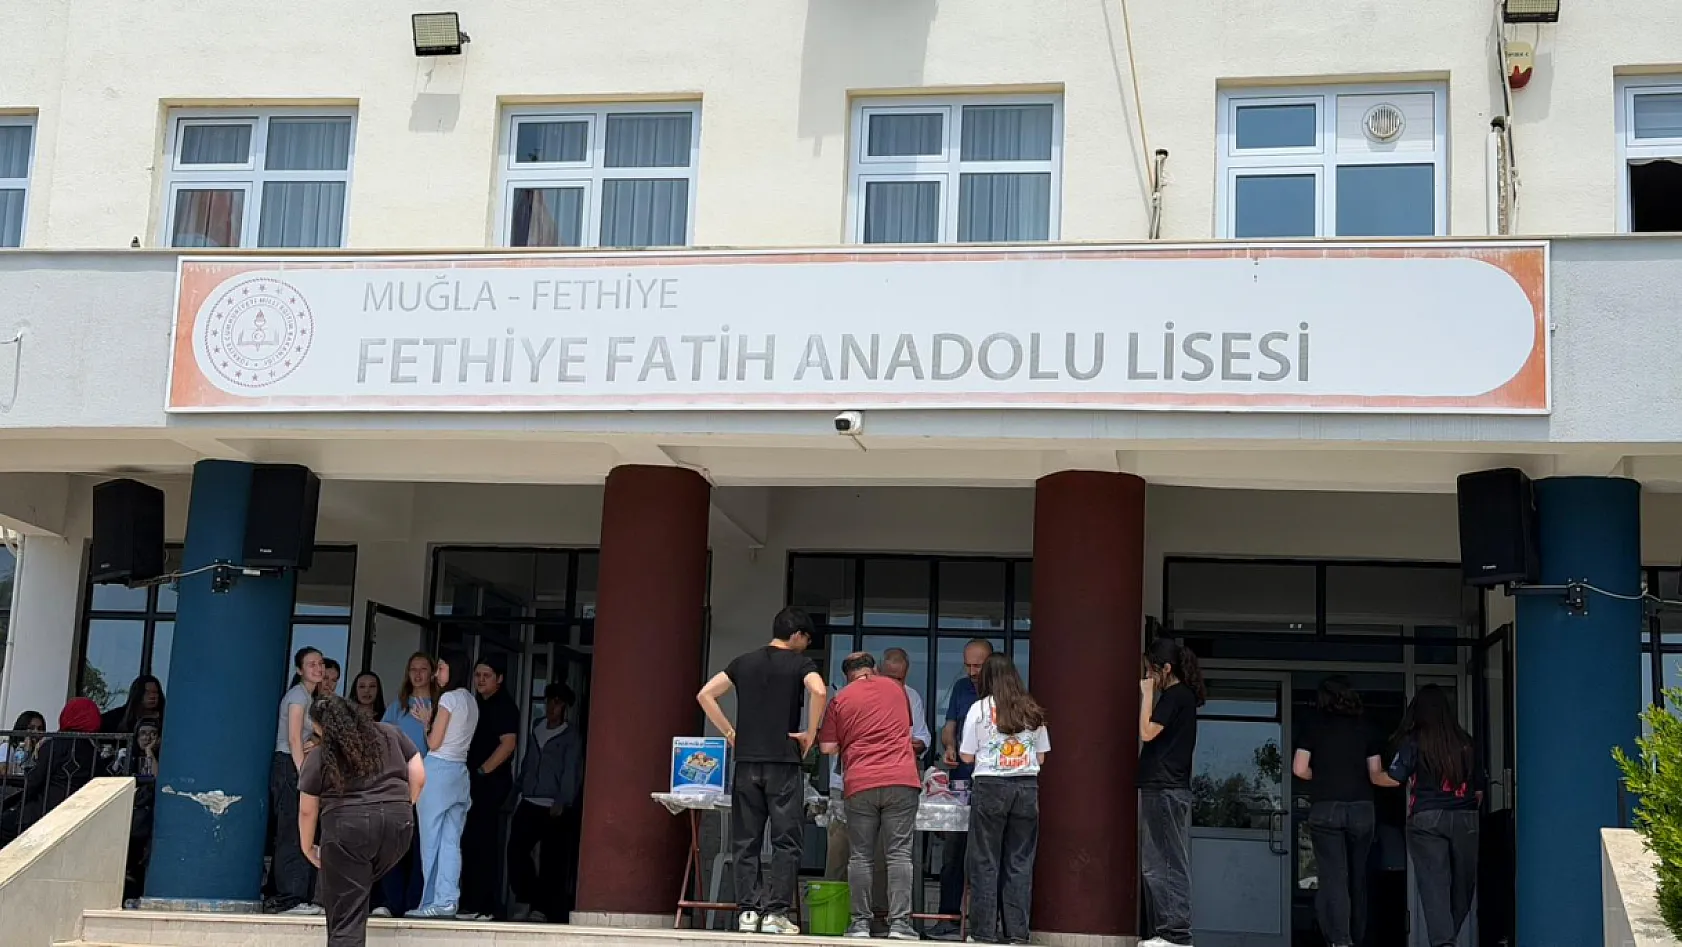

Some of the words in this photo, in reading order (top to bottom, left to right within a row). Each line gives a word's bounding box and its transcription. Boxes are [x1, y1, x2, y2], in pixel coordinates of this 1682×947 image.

[363, 275, 497, 312] MUĞLA
[532, 273, 679, 311] FETHİYE
[357, 328, 588, 384] FETHİYE
[606, 325, 776, 382] FATİH
[793, 331, 1105, 382] ANADOLU
[1127, 321, 1310, 382] LİSESİ
